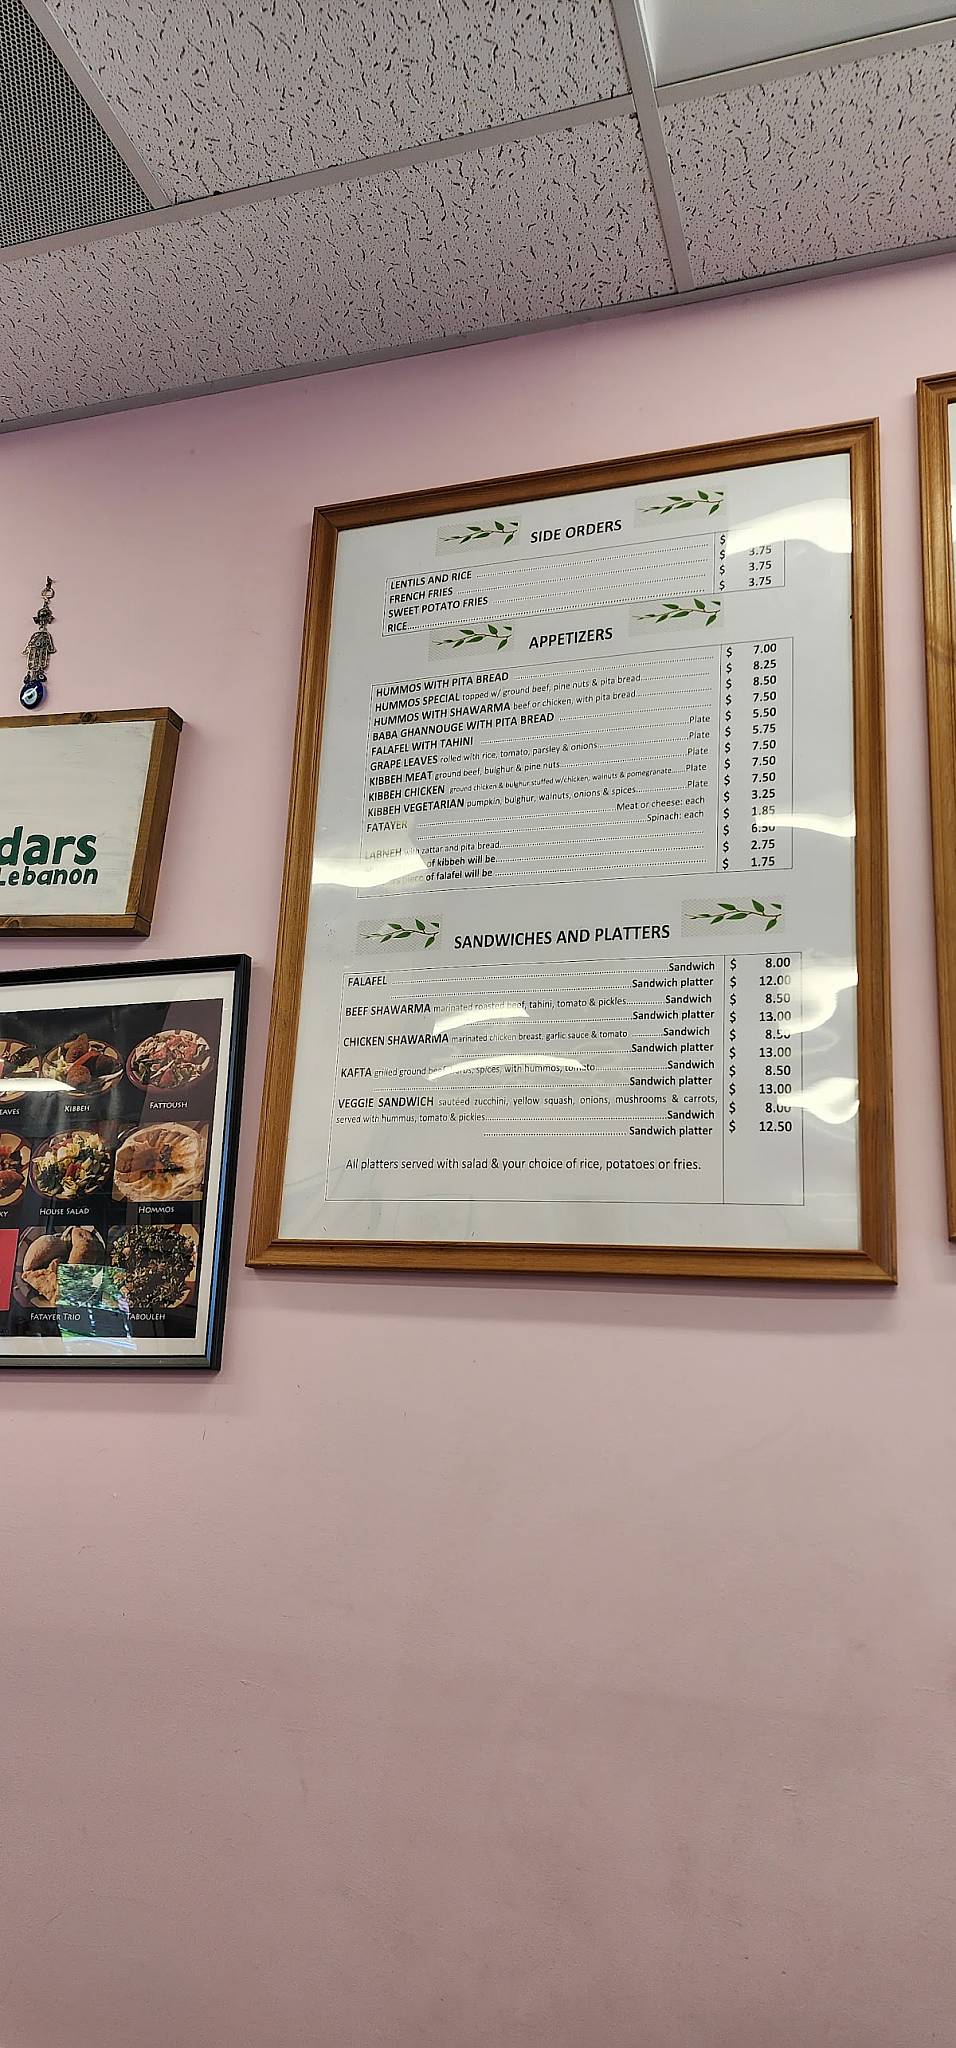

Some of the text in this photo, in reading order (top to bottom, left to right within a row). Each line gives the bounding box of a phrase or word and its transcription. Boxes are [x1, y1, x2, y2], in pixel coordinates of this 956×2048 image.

[530, 520, 621, 543] SIDE ORDERS
[388, 561, 772, 619] SWEET POTATO FRIES 3.75
[390, 571, 472, 590] LENTILS AND RICE
[387, 576, 772, 632] RICE 3.75
[390, 592, 425, 604] FRENCH
[428, 588, 453, 598] FRIES
[529, 628, 613, 649] APPETIZERS
[376, 644, 777, 697] HUMMOS WITH PITA BREAD 7.00
[375, 699, 420, 713] HUMMOS
[422, 693, 460, 707] SPECIAL
[600, 677, 616, 686] pita
[753, 660, 777, 670] 8.25
[374, 676, 777, 726] HUMMOS WITH SHAWARMA 8.50
[373, 691, 777, 742] BABA GHANNOUGE WITH PITA BREAD 7.50
[371, 708, 776, 756] FALAFEL WITH TAHINI Plate 5.50
[370, 724, 776, 772] GRAPE LEAVES Plate 5.75
[369, 740, 776, 787] KIBBEH MEAT Plate 7.50
[368, 756, 776, 802] KIBBEH CHICKEN Plate 7.50
[368, 773, 776, 817] KIBBEH VEGETARIAN Plate 7.50
[367, 821, 407, 832] FATAYER
[616, 803, 638, 811] Meat
[651, 799, 683, 809] cheese:
[685, 796, 705, 805] each
[752, 789, 775, 799] 3.25
[647, 806, 775, 822] Spinach: each 1.85
[0, 826, 97, 865] dars
[427, 839, 775, 868] of kibbeh will be 2.75
[426, 872, 434, 882] of
[436, 870, 462, 881] falafel
[465, 869, 480, 878] will
[482, 869, 493, 878] be
[751, 857, 775, 867] 1.75
[454, 925, 670, 949] SANDWICHES AND PLATTERS
[348, 958, 790, 986] FALAFEL Sandwich 8.00
[632, 976, 791, 989] Sandwich platter 12.00
[346, 993, 790, 1017] BEEF SHAWARMA Sandwich 8.50
[633, 1011, 791, 1021] Sandwich platter 13.00
[344, 1036, 385, 1046] CHICKEN
[387, 1034, 449, 1045] SHAWARMA
[663, 1027, 710, 1037] Sandwich
[632, 1043, 791, 1057] Sandwich platter 13.00
[341, 1060, 791, 1078] KAFTA Sandwich 8.50
[630, 1077, 792, 1094] Sandwich platter 13.00
[64, 1105, 90, 1113] KIBBEH
[149, 1101, 188, 1110] FATTOUSH
[338, 1099, 373, 1108] VEGGIE
[378, 1097, 434, 1106] SANDWICH
[513, 1097, 539, 1107] yellow
[544, 1097, 575, 1106] squash,
[580, 1096, 610, 1106] onions,
[615, 1095, 666, 1104] mushrooms
[672, 1095, 678, 1103] &
[683, 1095, 718, 1104] carrots,
[336, 1114, 361, 1123] served
[363, 1113, 380, 1123] with
[382, 1114, 417, 1123] hummus,
[420, 1113, 447, 1121] tomato
[450, 1113, 456, 1121] &
[667, 1110, 715, 1120] Sandwich
[629, 1122, 792, 1137] Sandwich platter 12.50
[346, 1158, 701, 1171] All platters served with salad & your choice of rice, potatoes or fries.
[39, 1207, 89, 1215] HOUSE SALAD
[139, 1206, 175, 1214] HOMMOS
[30, 1313, 81, 1321] FATAYER TRIO
[126, 1313, 166, 1321] TABOULEH
